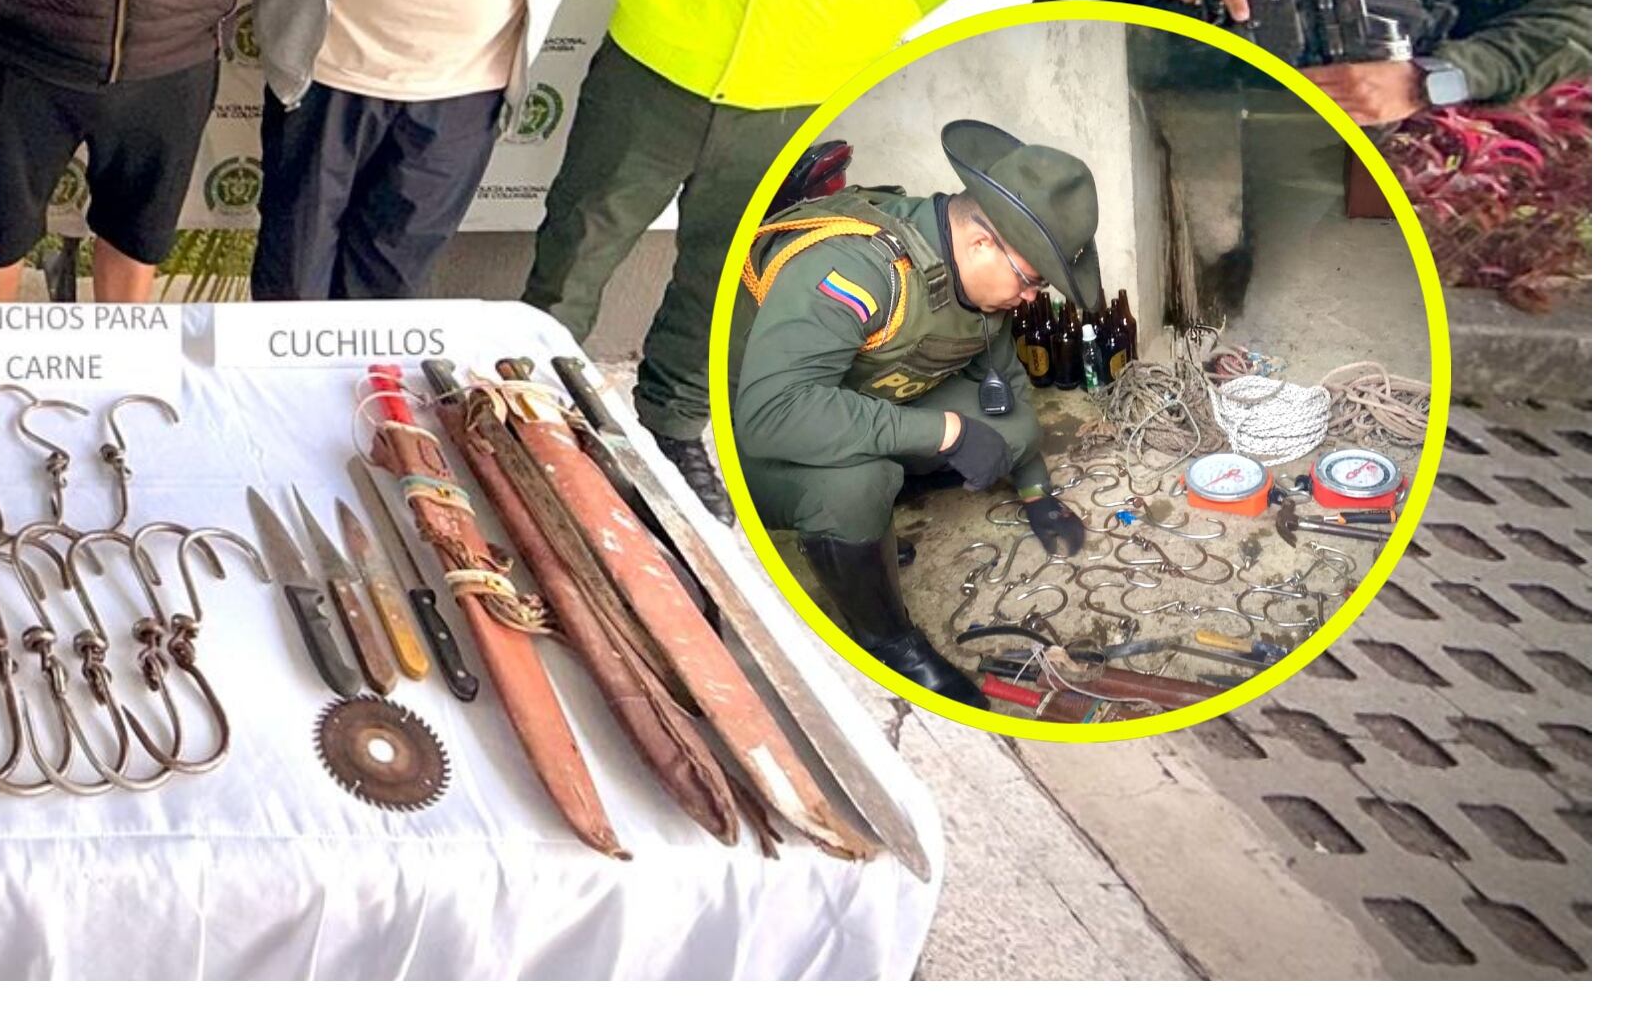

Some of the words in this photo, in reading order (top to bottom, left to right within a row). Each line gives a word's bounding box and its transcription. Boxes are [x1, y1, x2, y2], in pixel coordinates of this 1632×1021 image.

[94, 306, 169, 331] PARA
[268, 328, 445, 359] CUCHILLOS
[5, 354, 103, 380] CARNE
